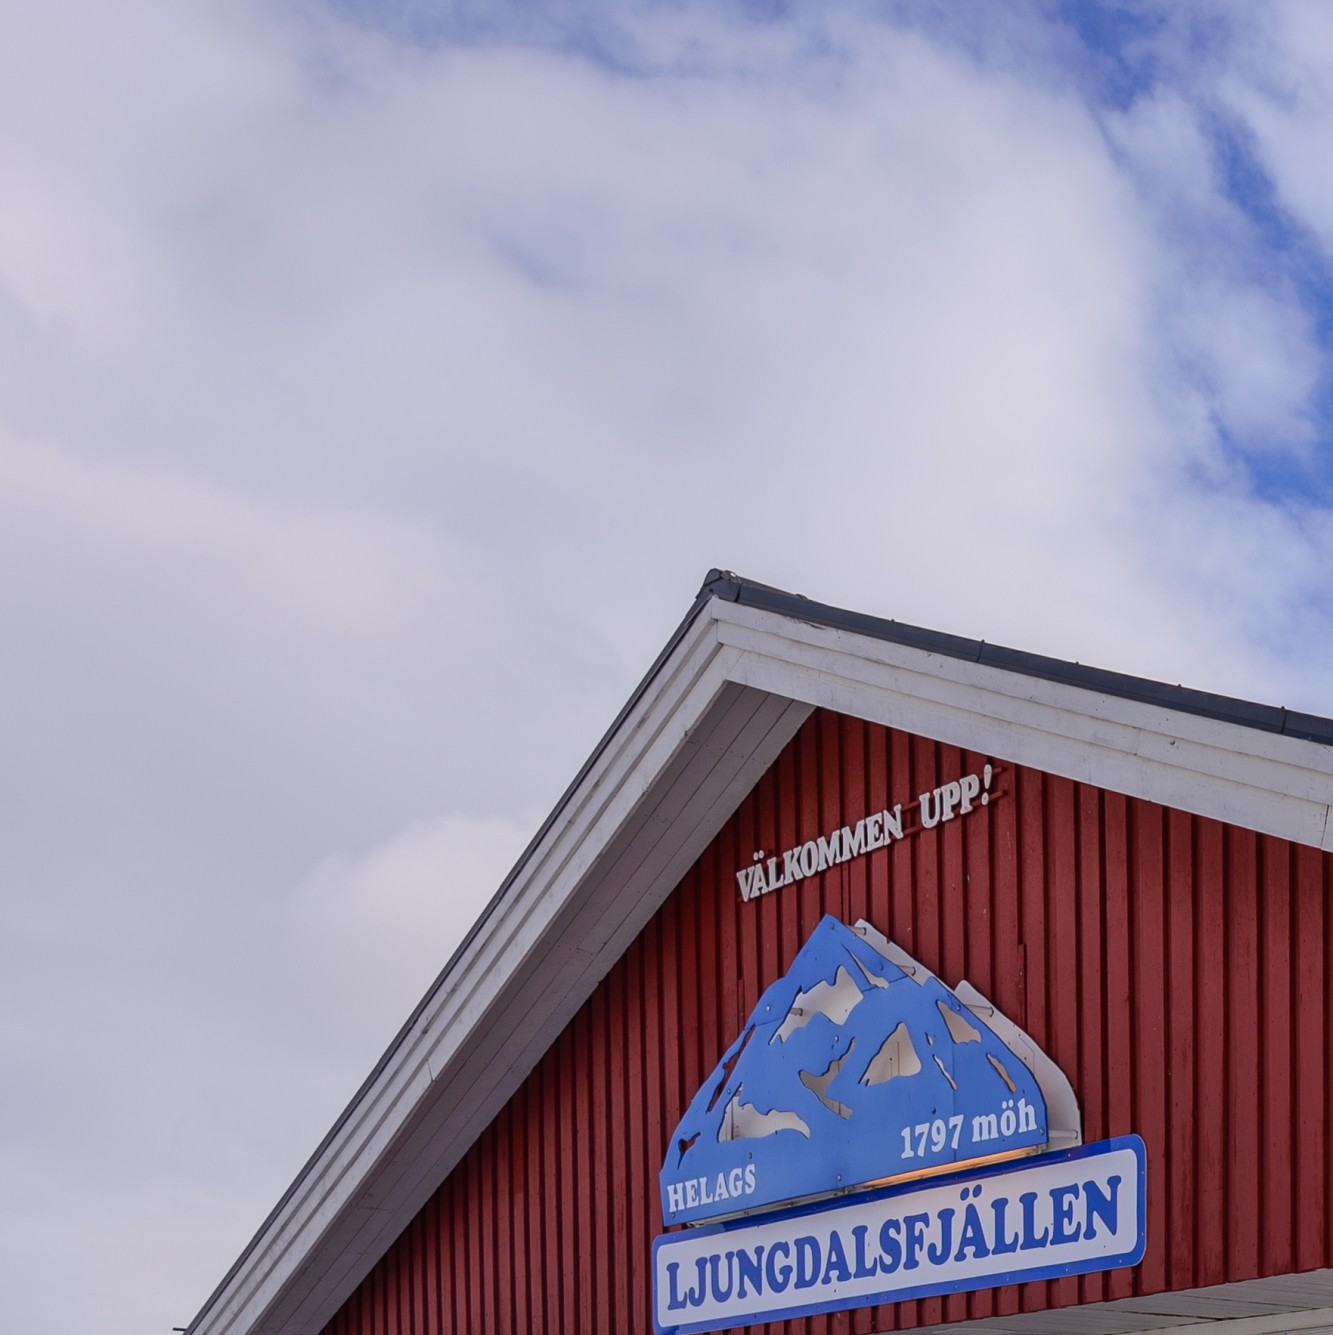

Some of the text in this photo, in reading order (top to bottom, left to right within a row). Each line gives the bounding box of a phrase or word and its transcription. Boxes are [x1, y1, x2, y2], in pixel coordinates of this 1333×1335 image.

[736, 763, 993, 903] VÄLKOMMEN UPP!
[901, 1097, 1038, 1160] 1797 möh
[666, 1162, 757, 1215] HELAGS
[666, 1174, 1123, 1311] LJUNGDALSFJÄLLEN
